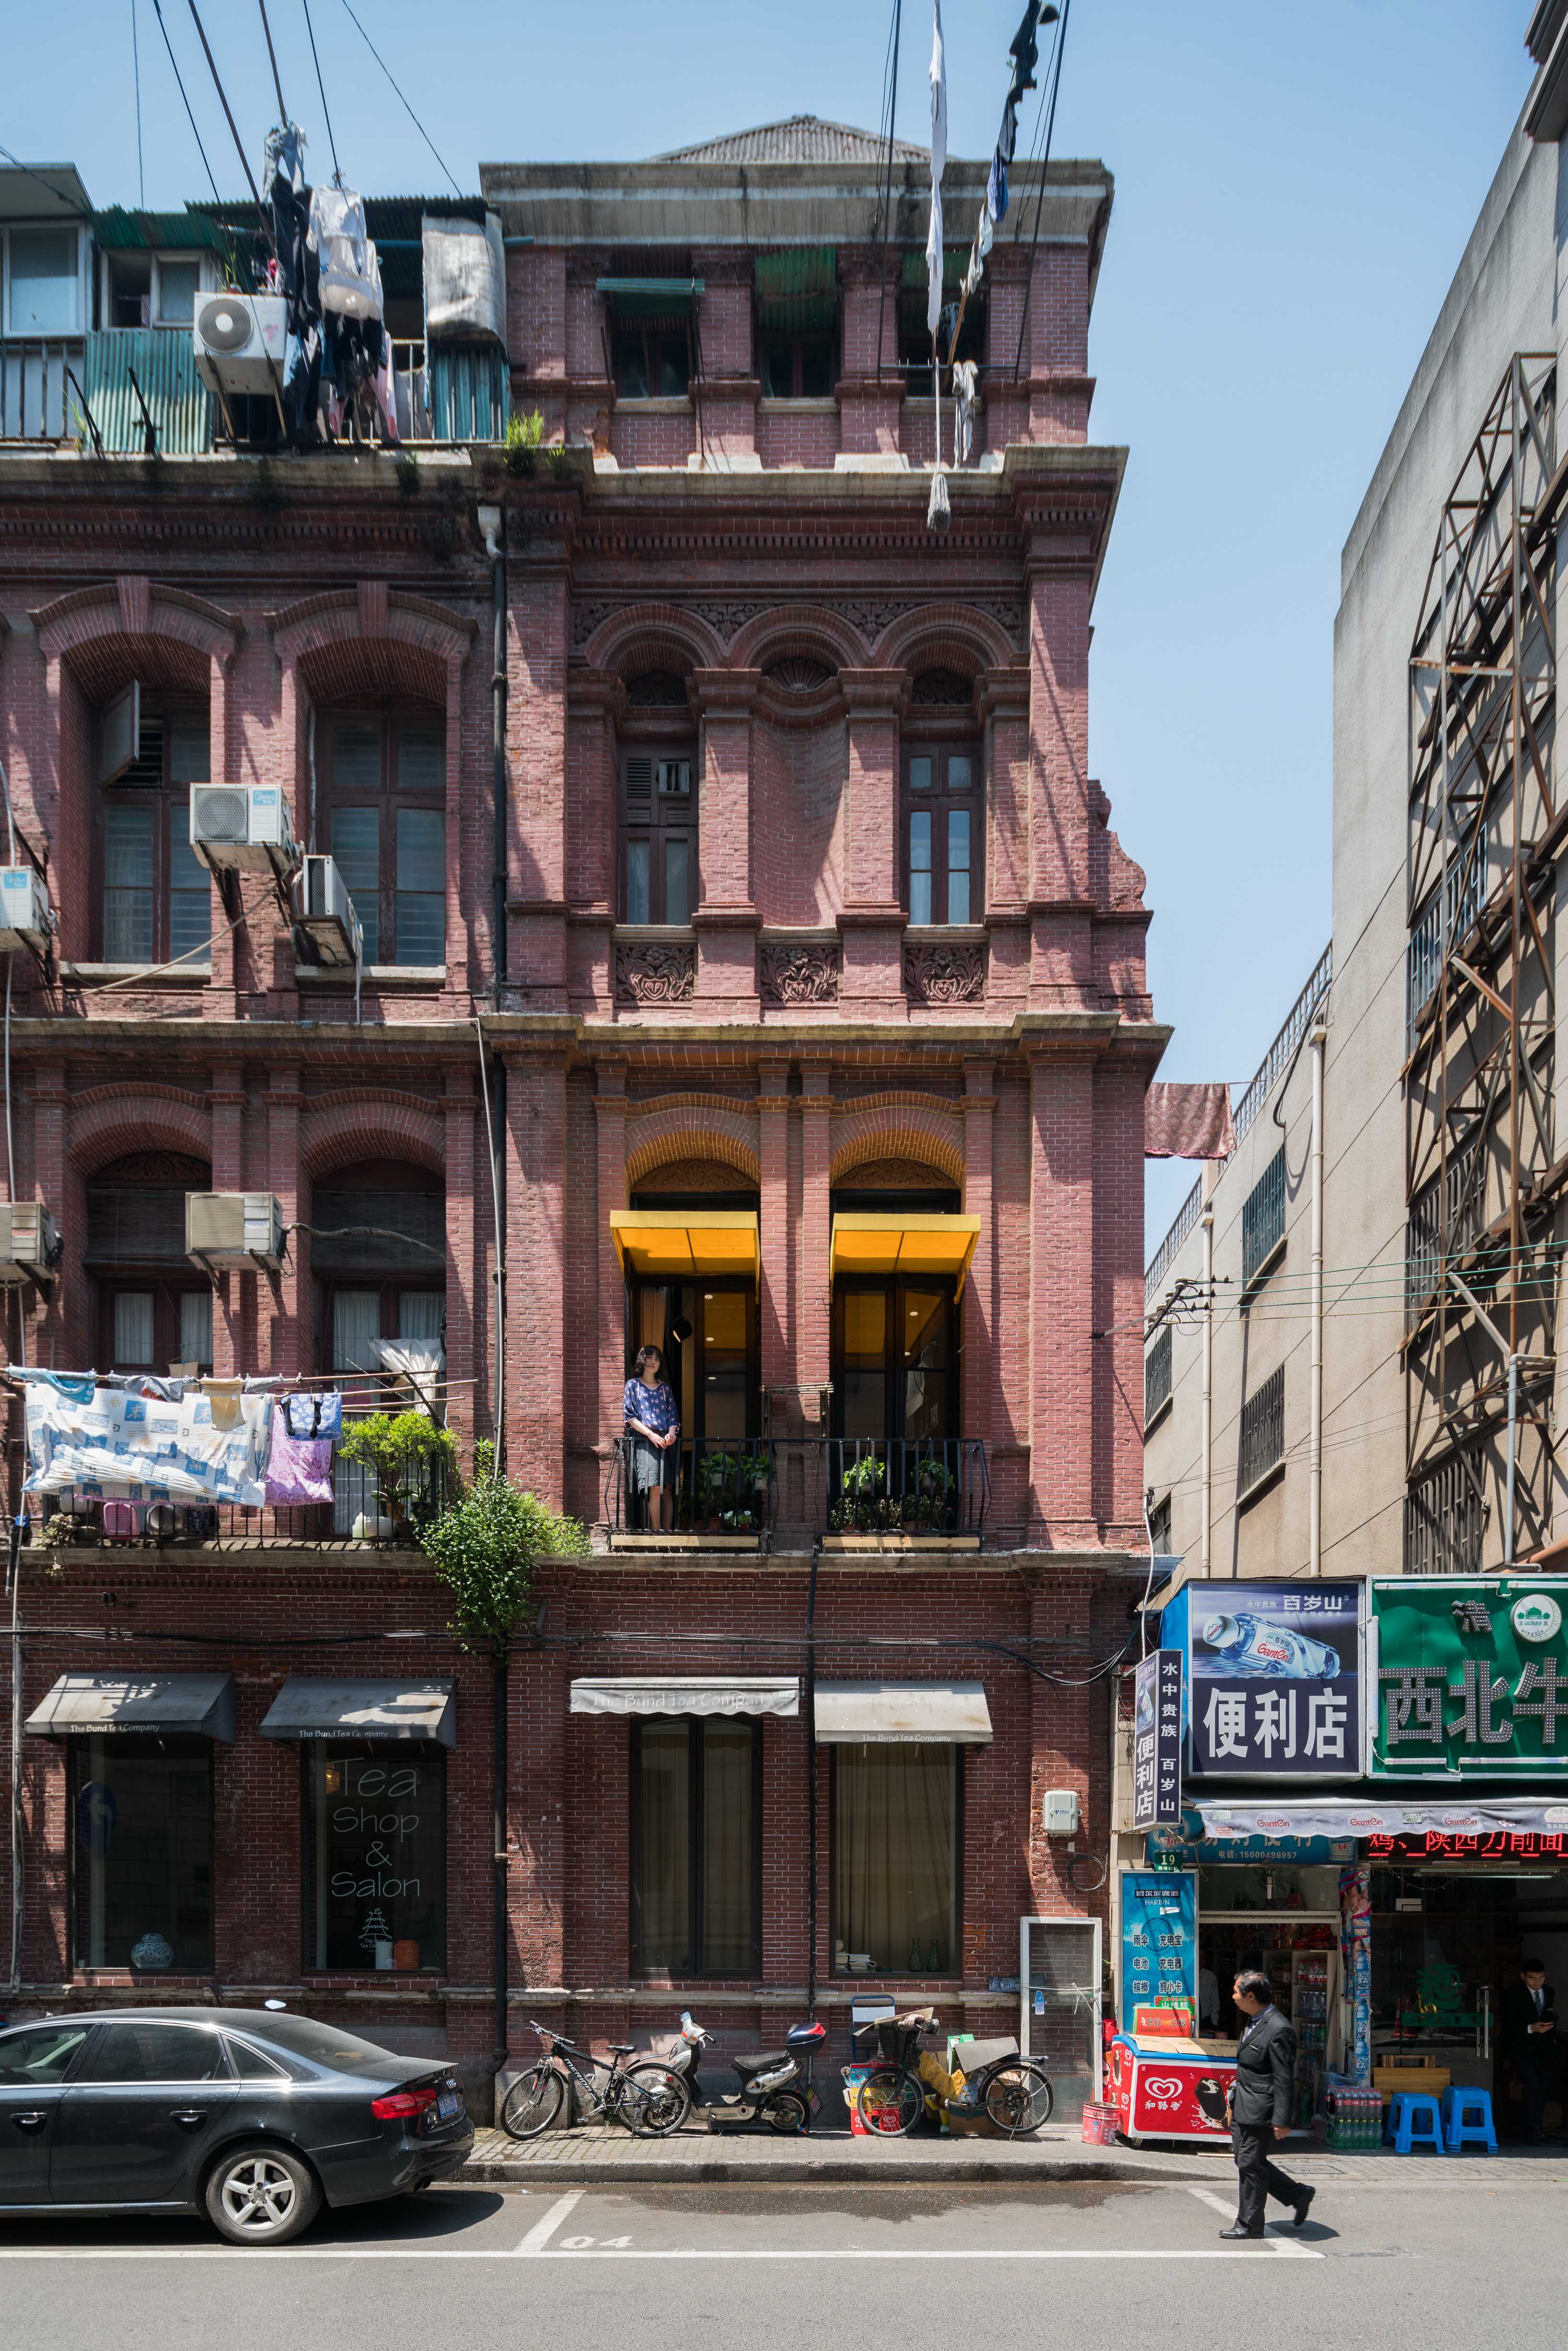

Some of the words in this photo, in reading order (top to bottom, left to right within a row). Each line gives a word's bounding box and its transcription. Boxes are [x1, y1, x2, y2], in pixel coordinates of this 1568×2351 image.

[1247, 1600, 1277, 1608] 水中贵族
[1283, 1595, 1342, 1611] 百岁山
[1274, 1636, 1290, 1647] 百岁山
[594, 1694, 620, 1707] The
[625, 1693, 665, 1708] Bund
[670, 1694, 696, 1707] Tea
[701, 1693, 772, 1710] Company
[1161, 1662, 1178, 1737] 水中贵族
[1379, 1657, 1568, 1745] 西北牛
[123, 1723, 160, 1733] Company
[1203, 1687, 1347, 1758] 便利店
[315, 1730, 335, 1738] Bund
[878, 1734, 898, 1742] Bund
[900, 1734, 913, 1742] Tea
[915, 1734, 951, 1743] Company
[331, 1757, 417, 1796] Tea
[1136, 1733, 1154, 1817] 便利店
[1160, 1758, 1177, 1812] 百岁山
[333, 1807, 419, 1843] Shop
[366, 1841, 392, 1866] &
[1161, 1854, 1175, 1865] 19
[331, 1872, 420, 1897] Salon
[1133, 1934, 1148, 1946] 雨伞
[1159, 1934, 1182, 1946] 充电宝
[1133, 1958, 1149, 1970] 电池
[1159, 1958, 1182, 1970] 充电器
[1159, 1981, 1182, 1993] 剪小卡
[1145, 2100, 1181, 2111] 和路雪
[559, 2236, 638, 2249] 04
